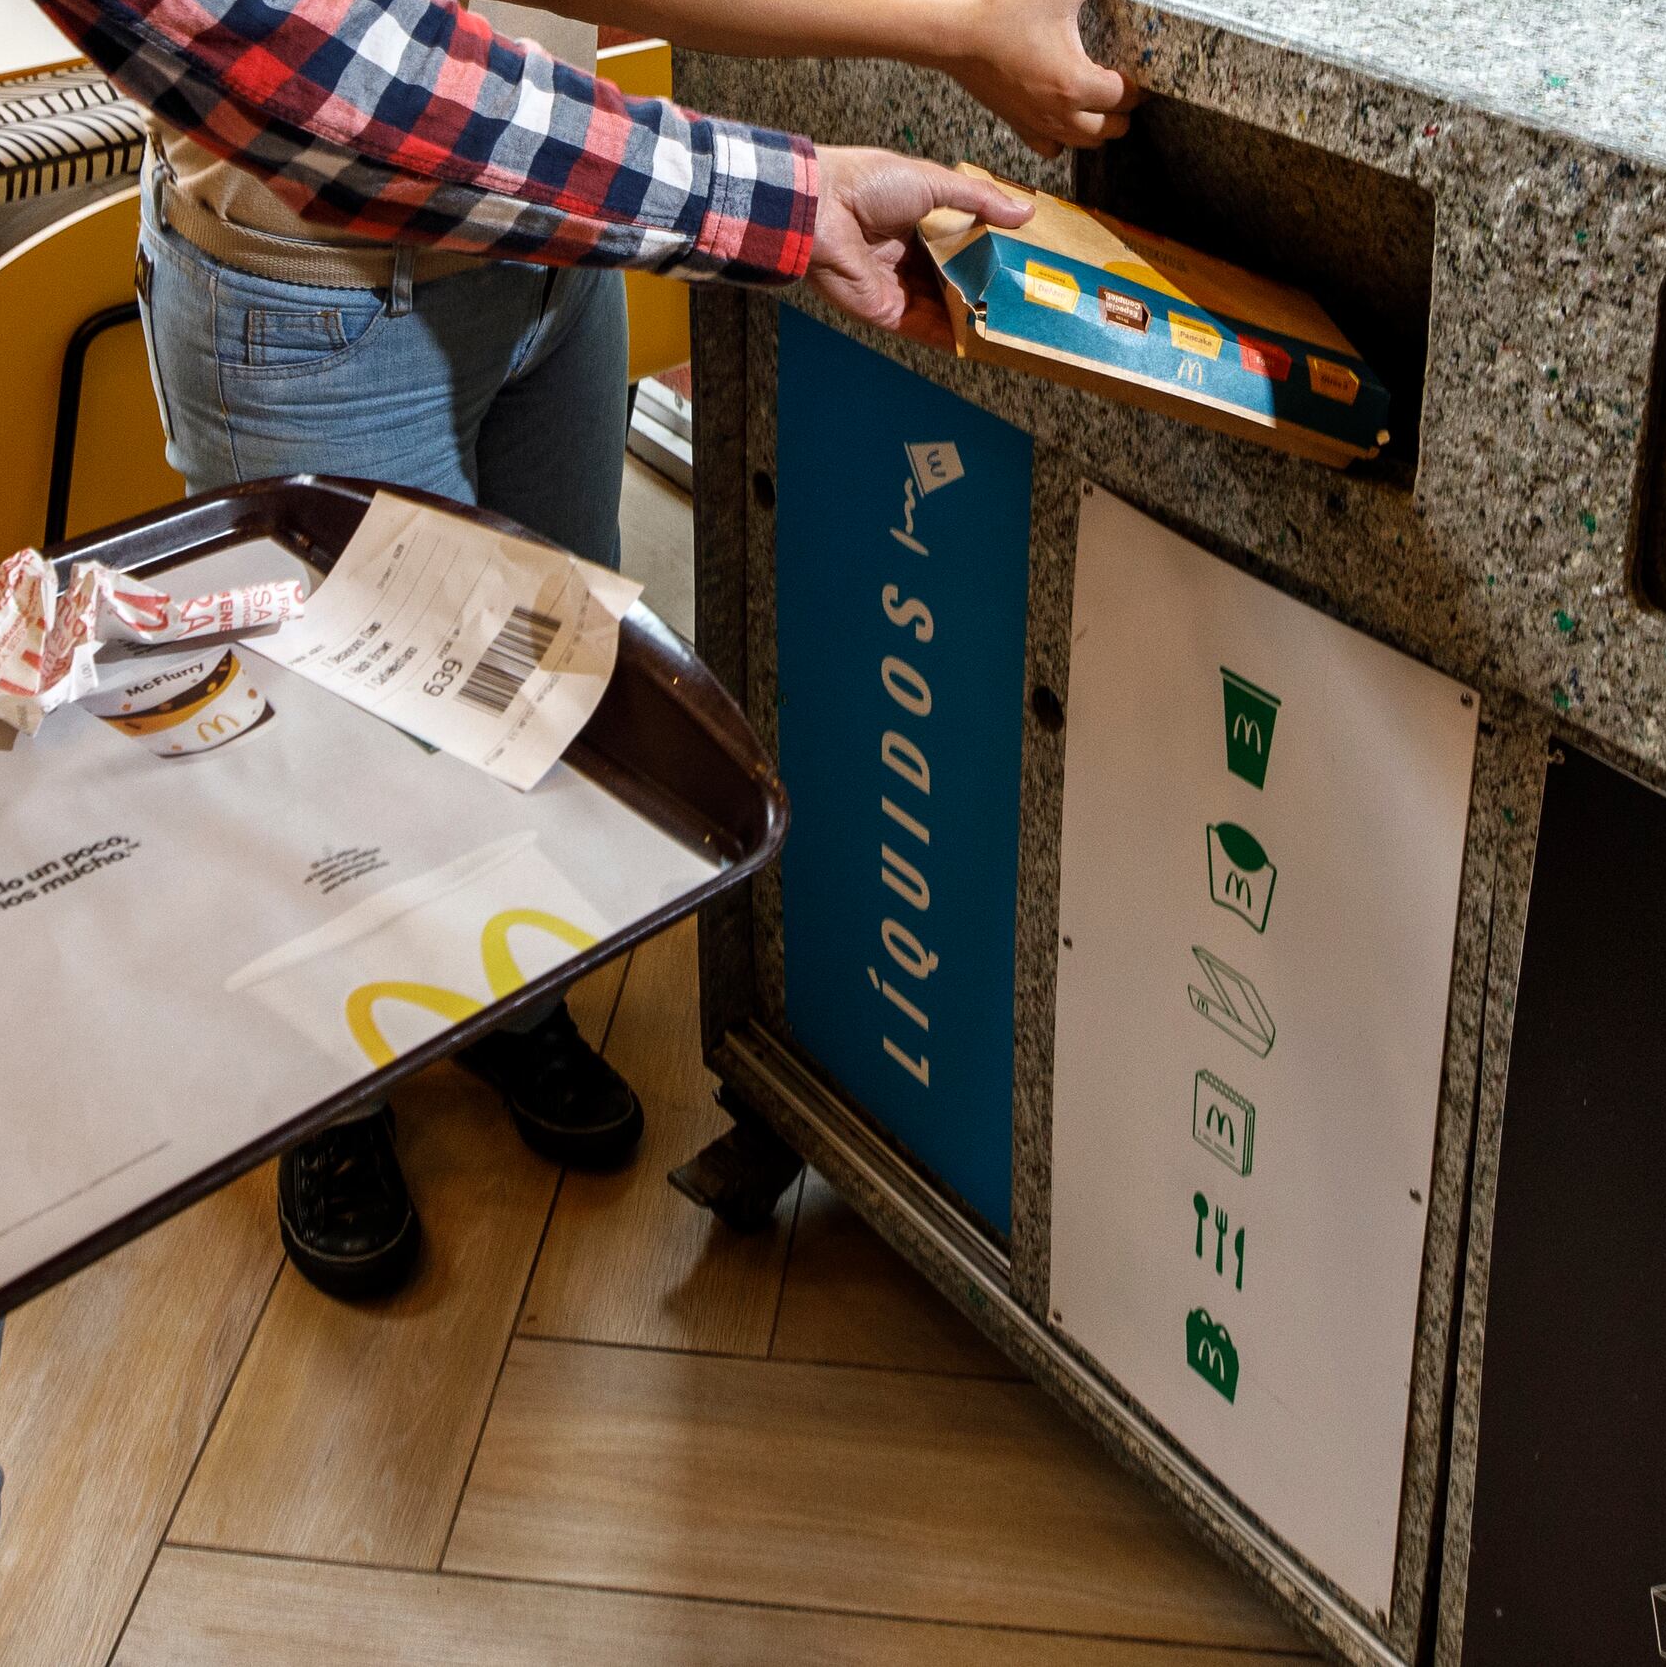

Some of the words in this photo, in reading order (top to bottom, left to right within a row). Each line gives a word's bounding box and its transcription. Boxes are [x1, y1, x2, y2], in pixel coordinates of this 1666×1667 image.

[125, 661, 204, 698] McFlurry
[422, 657, 464, 698] 639
[866, 582, 940, 1089] LÍQUIDOS
[25, 859, 61, 883] un
[61, 835, 131, 868] poco,
